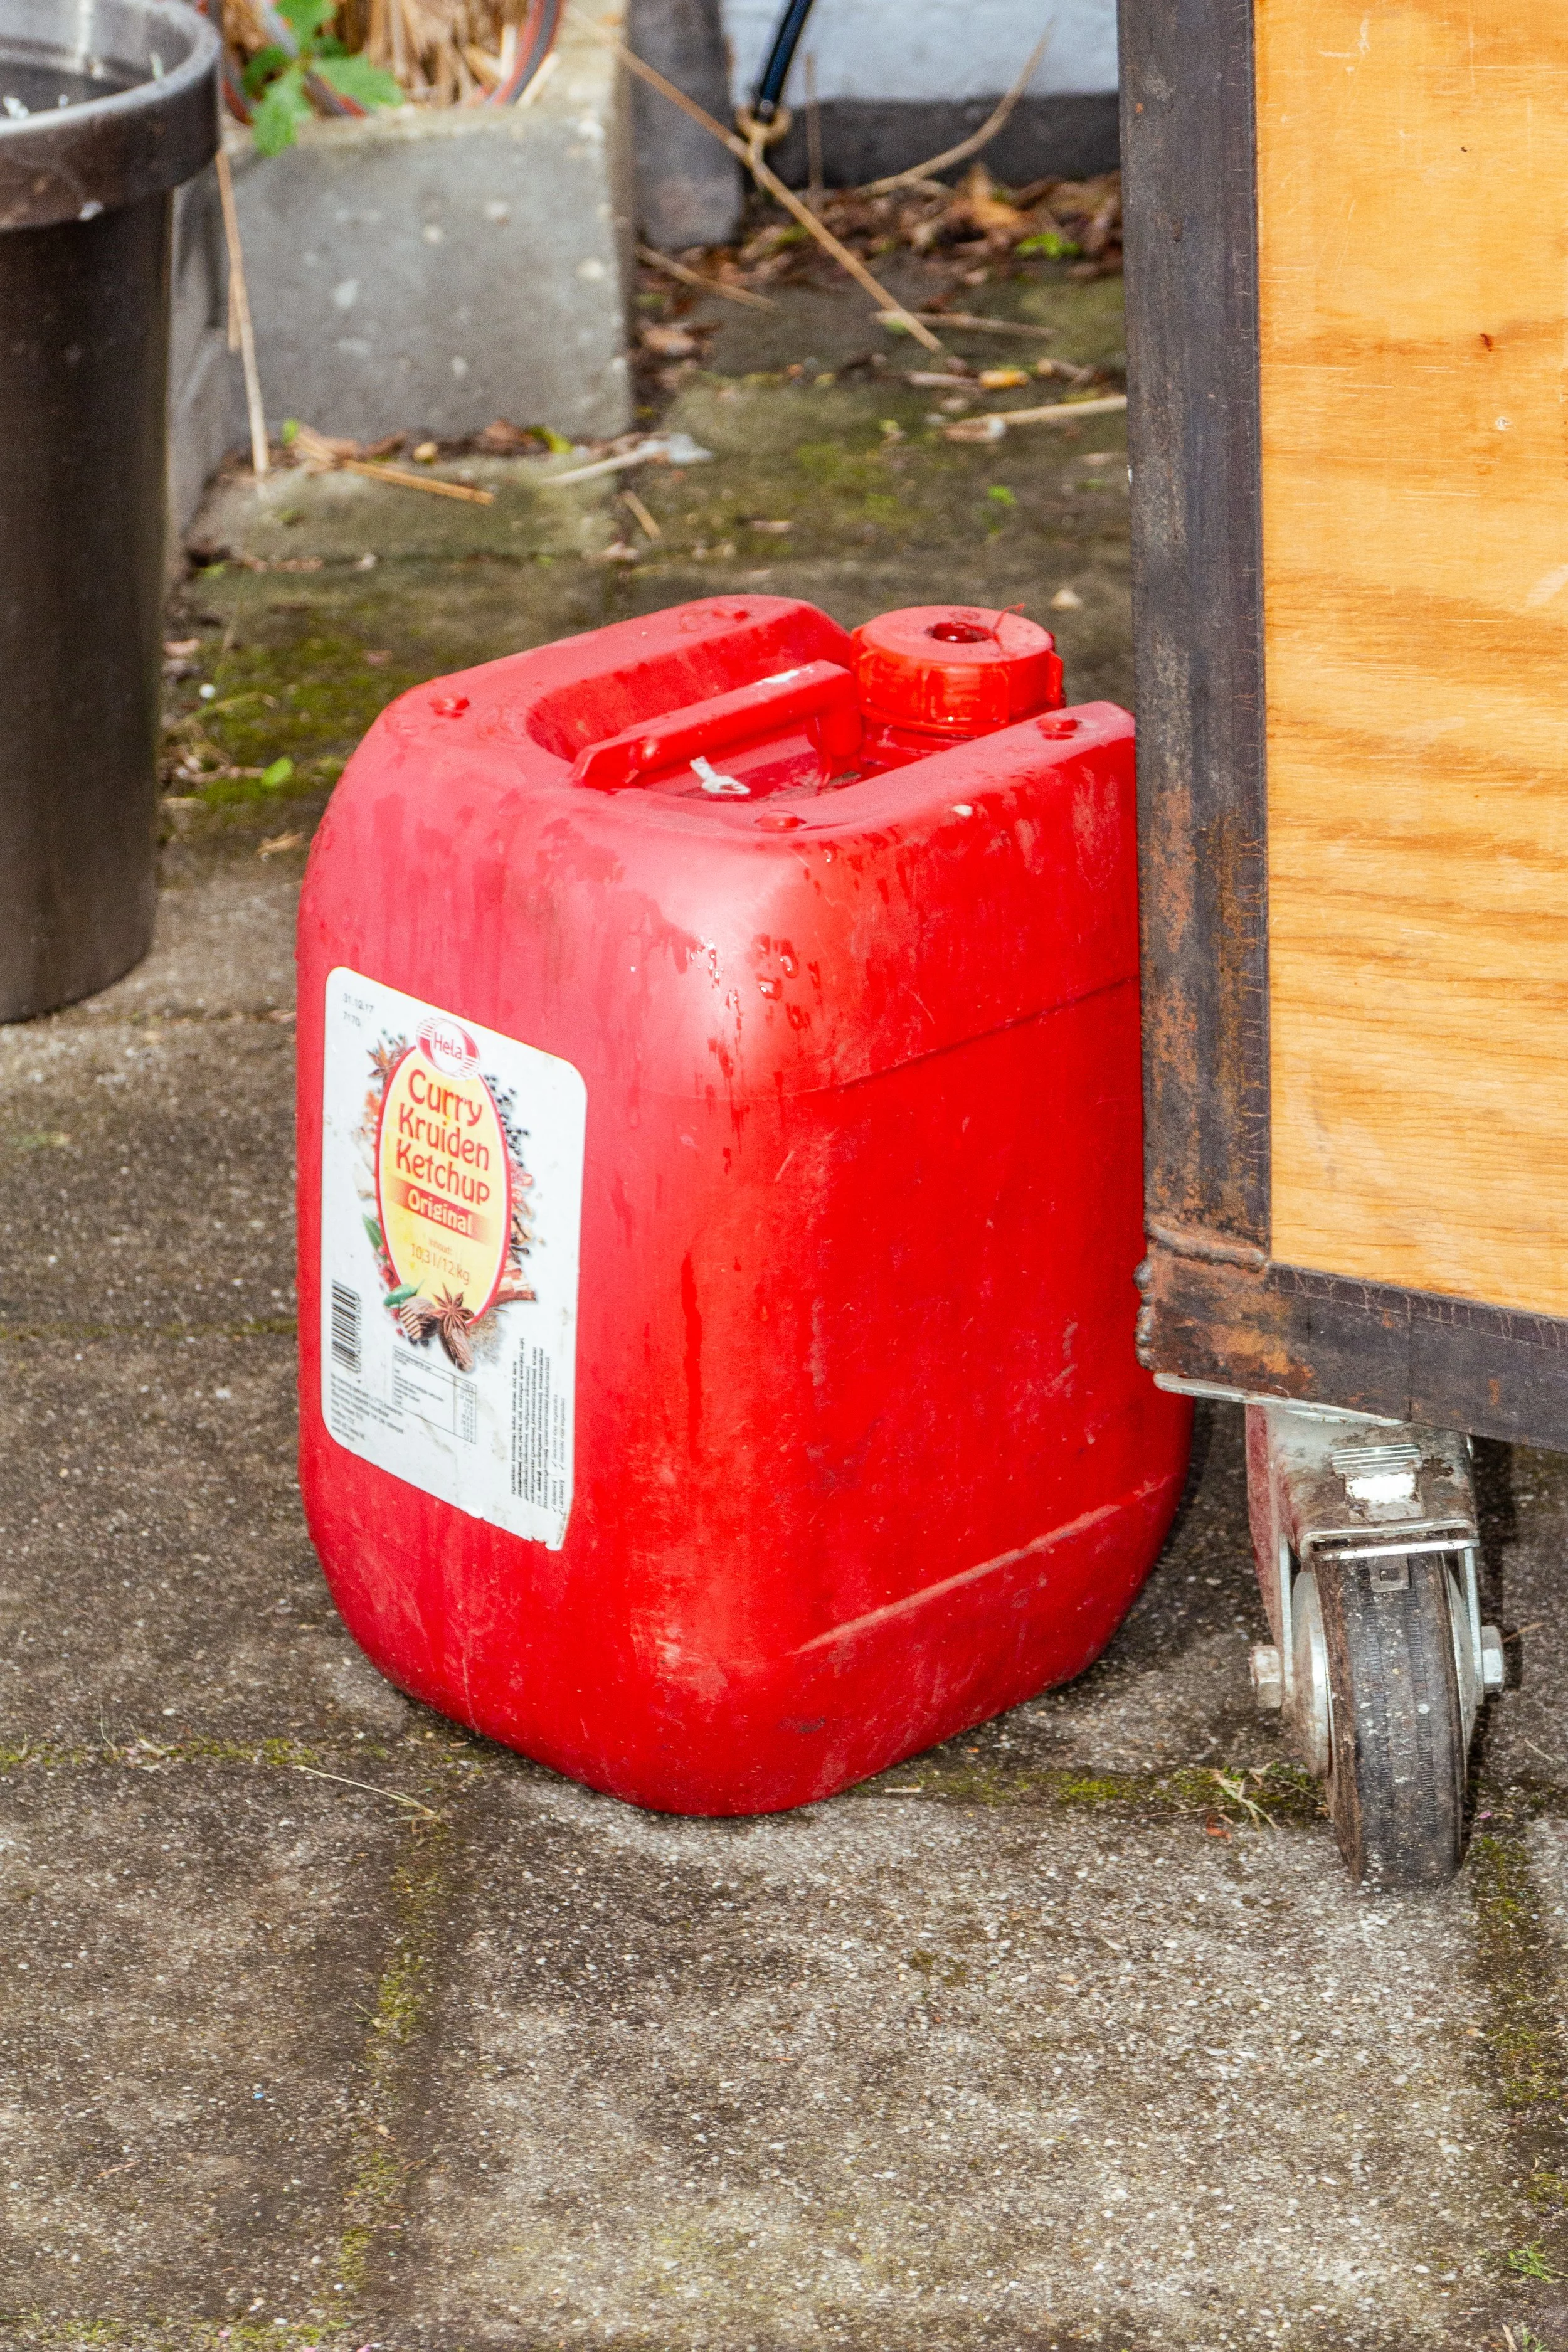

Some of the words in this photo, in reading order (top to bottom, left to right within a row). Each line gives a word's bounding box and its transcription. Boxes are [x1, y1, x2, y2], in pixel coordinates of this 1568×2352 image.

[433, 1032, 463, 1060] Hela
[408, 1069, 482, 1127] Curry
[398, 1103, 489, 1171] Kruiden
[396, 1138, 490, 1205] Ketchup
[408, 1189, 473, 1236] Original
[457, 1264, 470, 1285] kg
